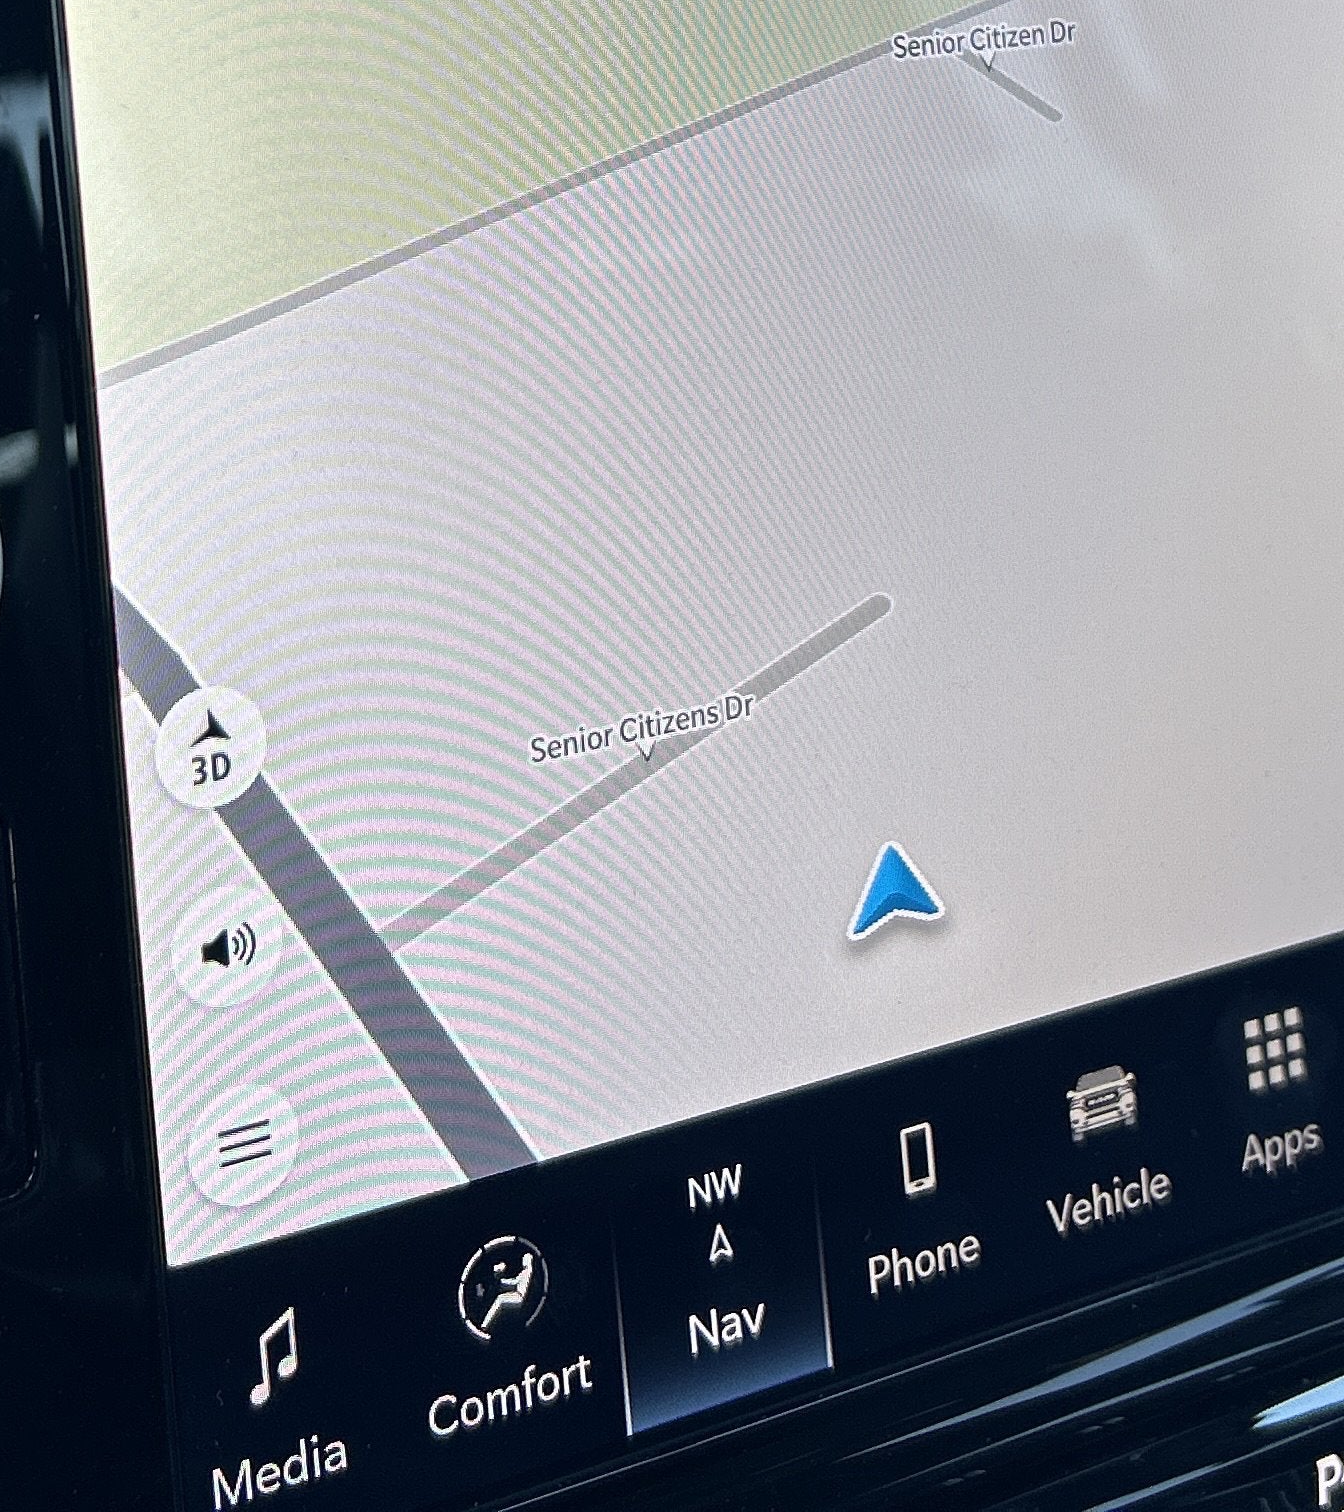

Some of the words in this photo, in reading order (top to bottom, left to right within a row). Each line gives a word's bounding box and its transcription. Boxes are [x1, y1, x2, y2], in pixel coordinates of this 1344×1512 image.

[893, 31, 965, 58] Senior
[970, 24, 1044, 50] Citizen
[1051, 20, 1076, 43] Dr
[531, 727, 613, 763] Senior
[620, 703, 719, 743] Citizens
[725, 695, 754, 720] Dr
[192, 752, 231, 787] 3D
[1242, 1120, 1323, 1177] Apps
[688, 1164, 742, 1210] NW
[1046, 1167, 1173, 1234] Vehicle
[868, 1235, 982, 1297] Phone
[688, 1303, 765, 1357] Nav
[428, 1355, 593, 1439] Comfort
[212, 1434, 349, 1511] Media
